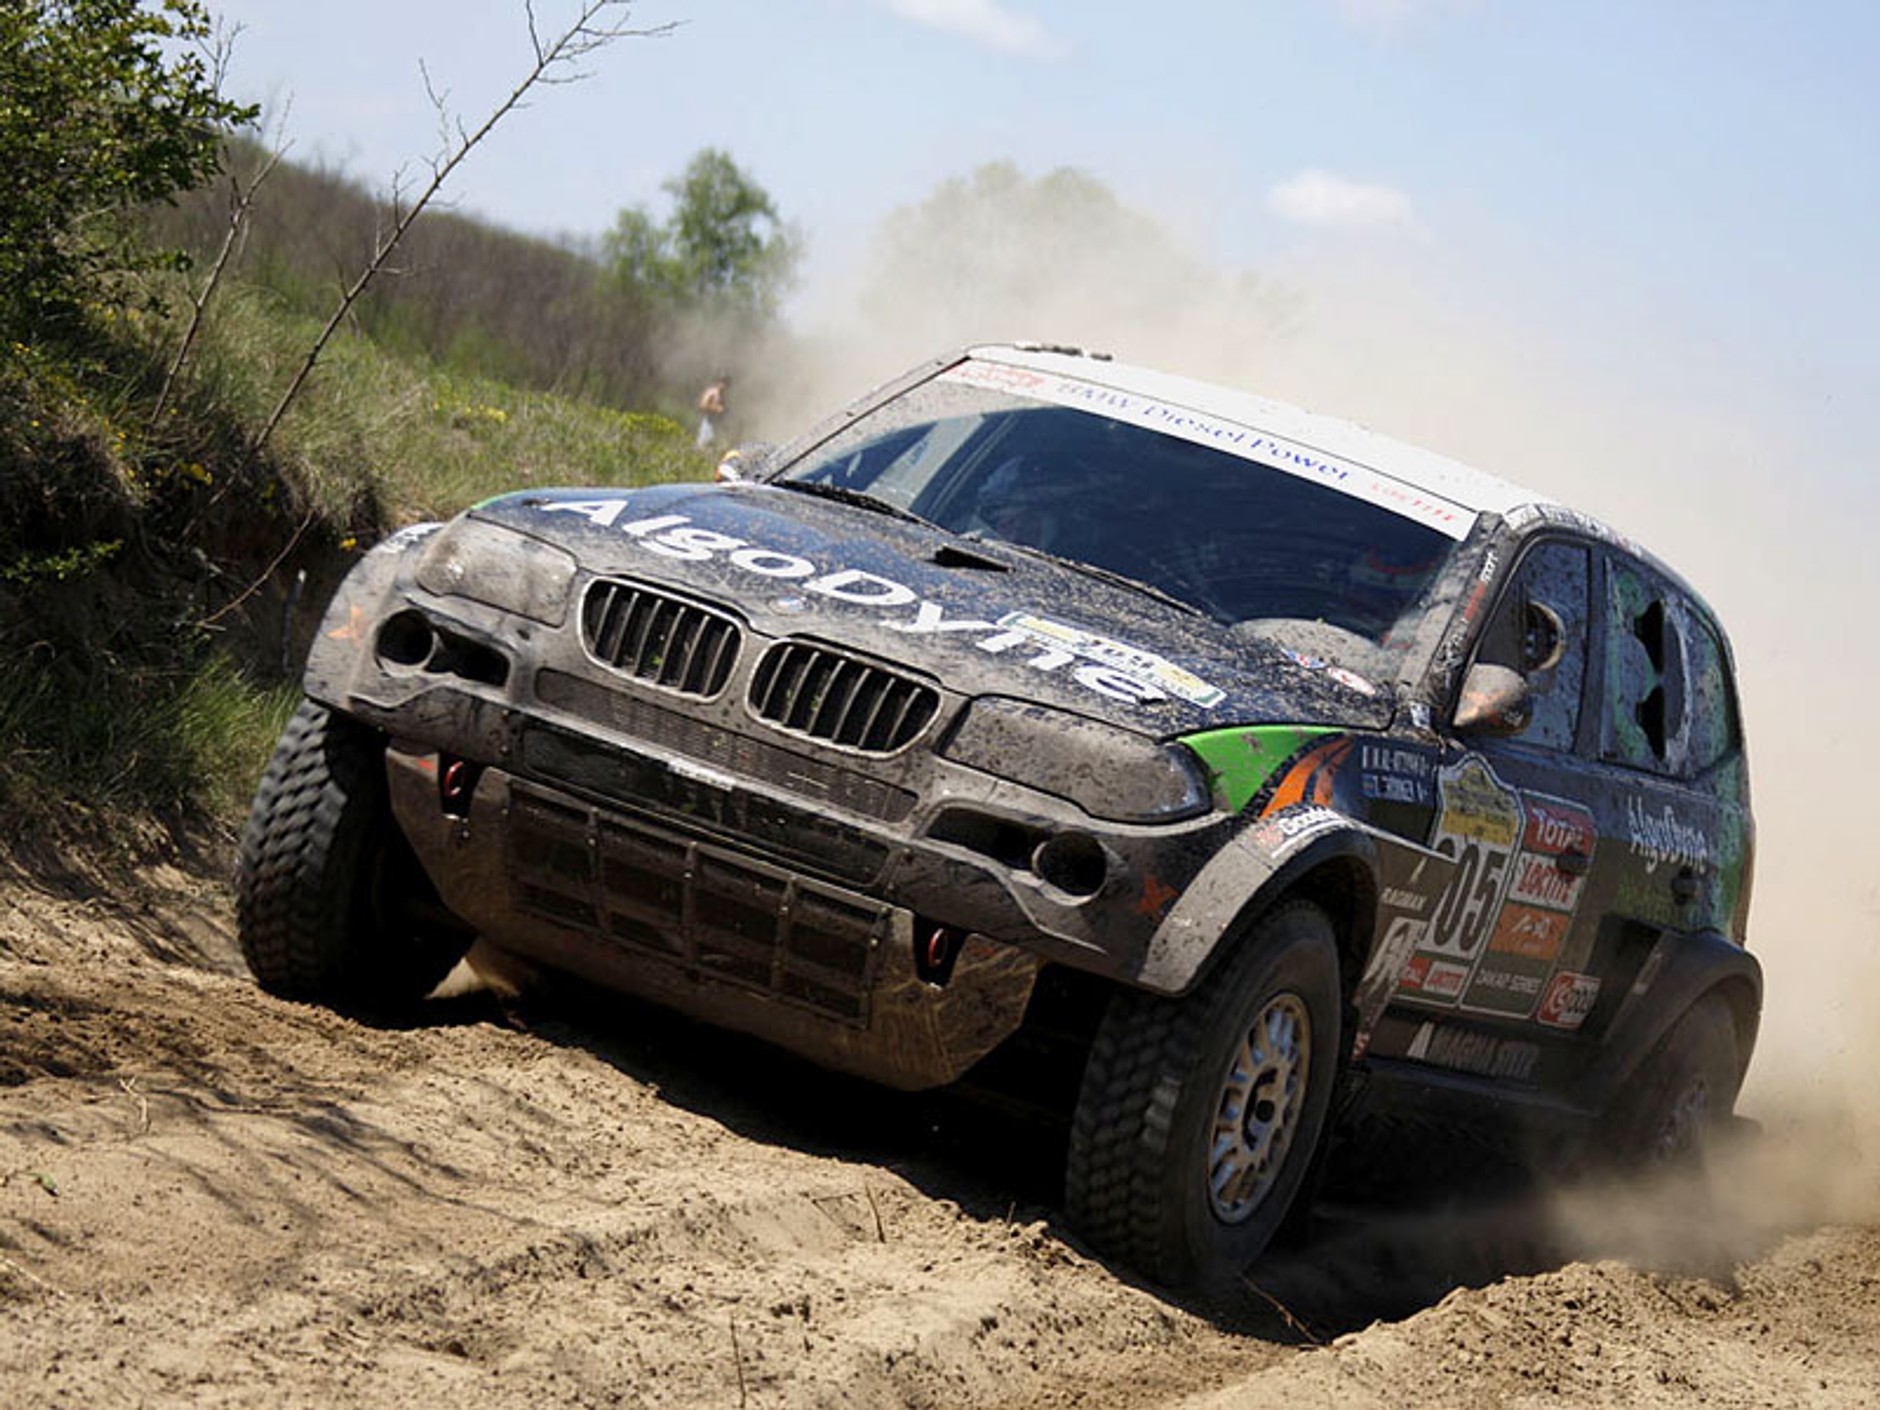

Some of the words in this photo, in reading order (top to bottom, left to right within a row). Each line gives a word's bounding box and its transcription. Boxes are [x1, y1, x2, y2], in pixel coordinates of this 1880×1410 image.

[1143, 405, 1245, 443] Diesel
[1250, 438, 1349, 480] Power
[537, 497, 1168, 704] AlgoDyne
[1532, 808, 1586, 850] TOTAL
[1434, 837, 1510, 952] 05
